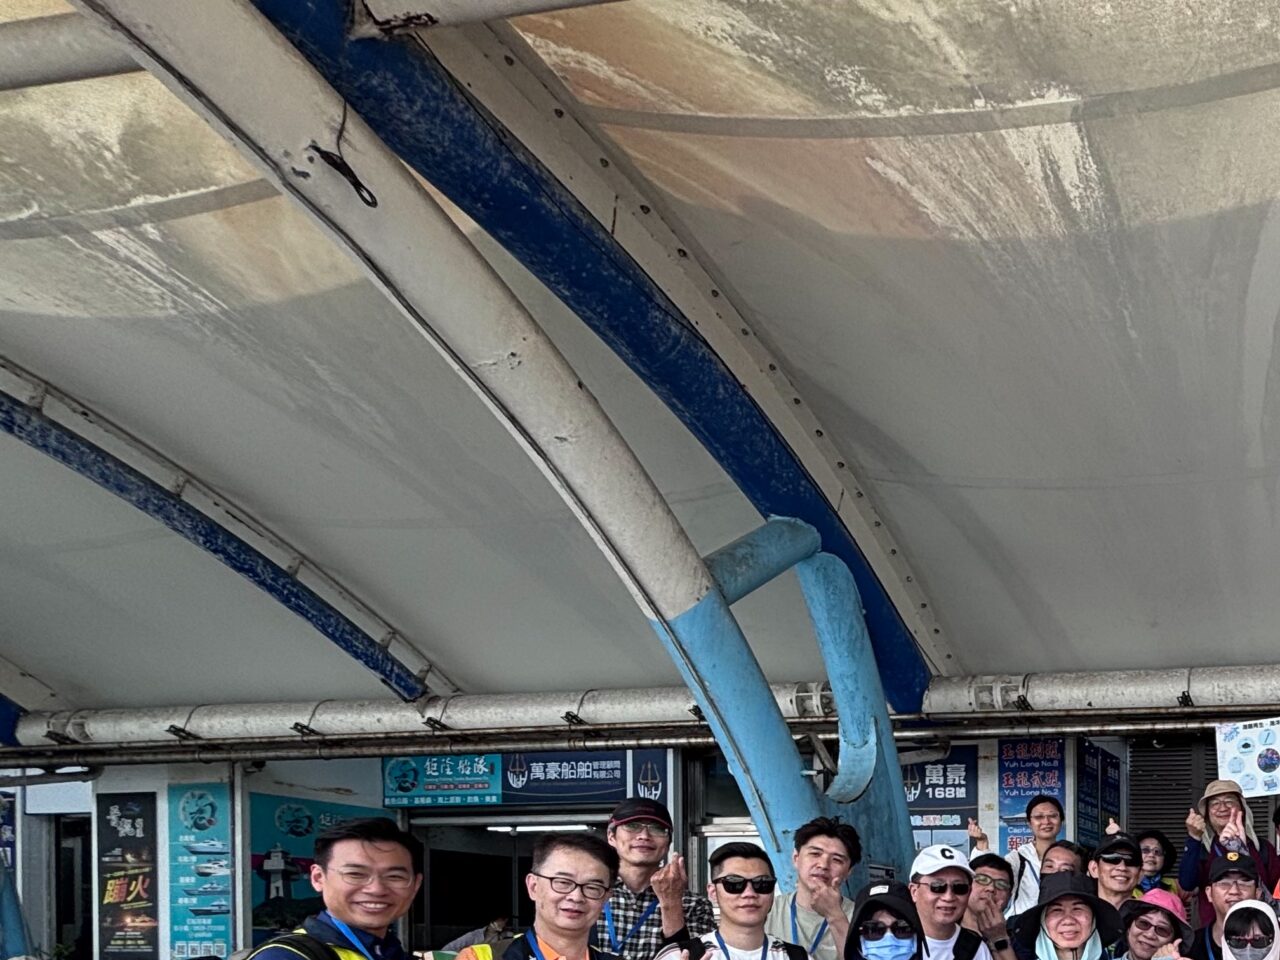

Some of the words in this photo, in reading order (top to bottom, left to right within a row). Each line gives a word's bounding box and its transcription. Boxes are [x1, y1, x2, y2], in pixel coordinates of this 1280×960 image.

[529, 761, 593, 780] 萬豪船舶
[924, 764, 967, 785] 萬豪
[925, 786, 967, 798] 168號
[940, 847, 955, 860] C
